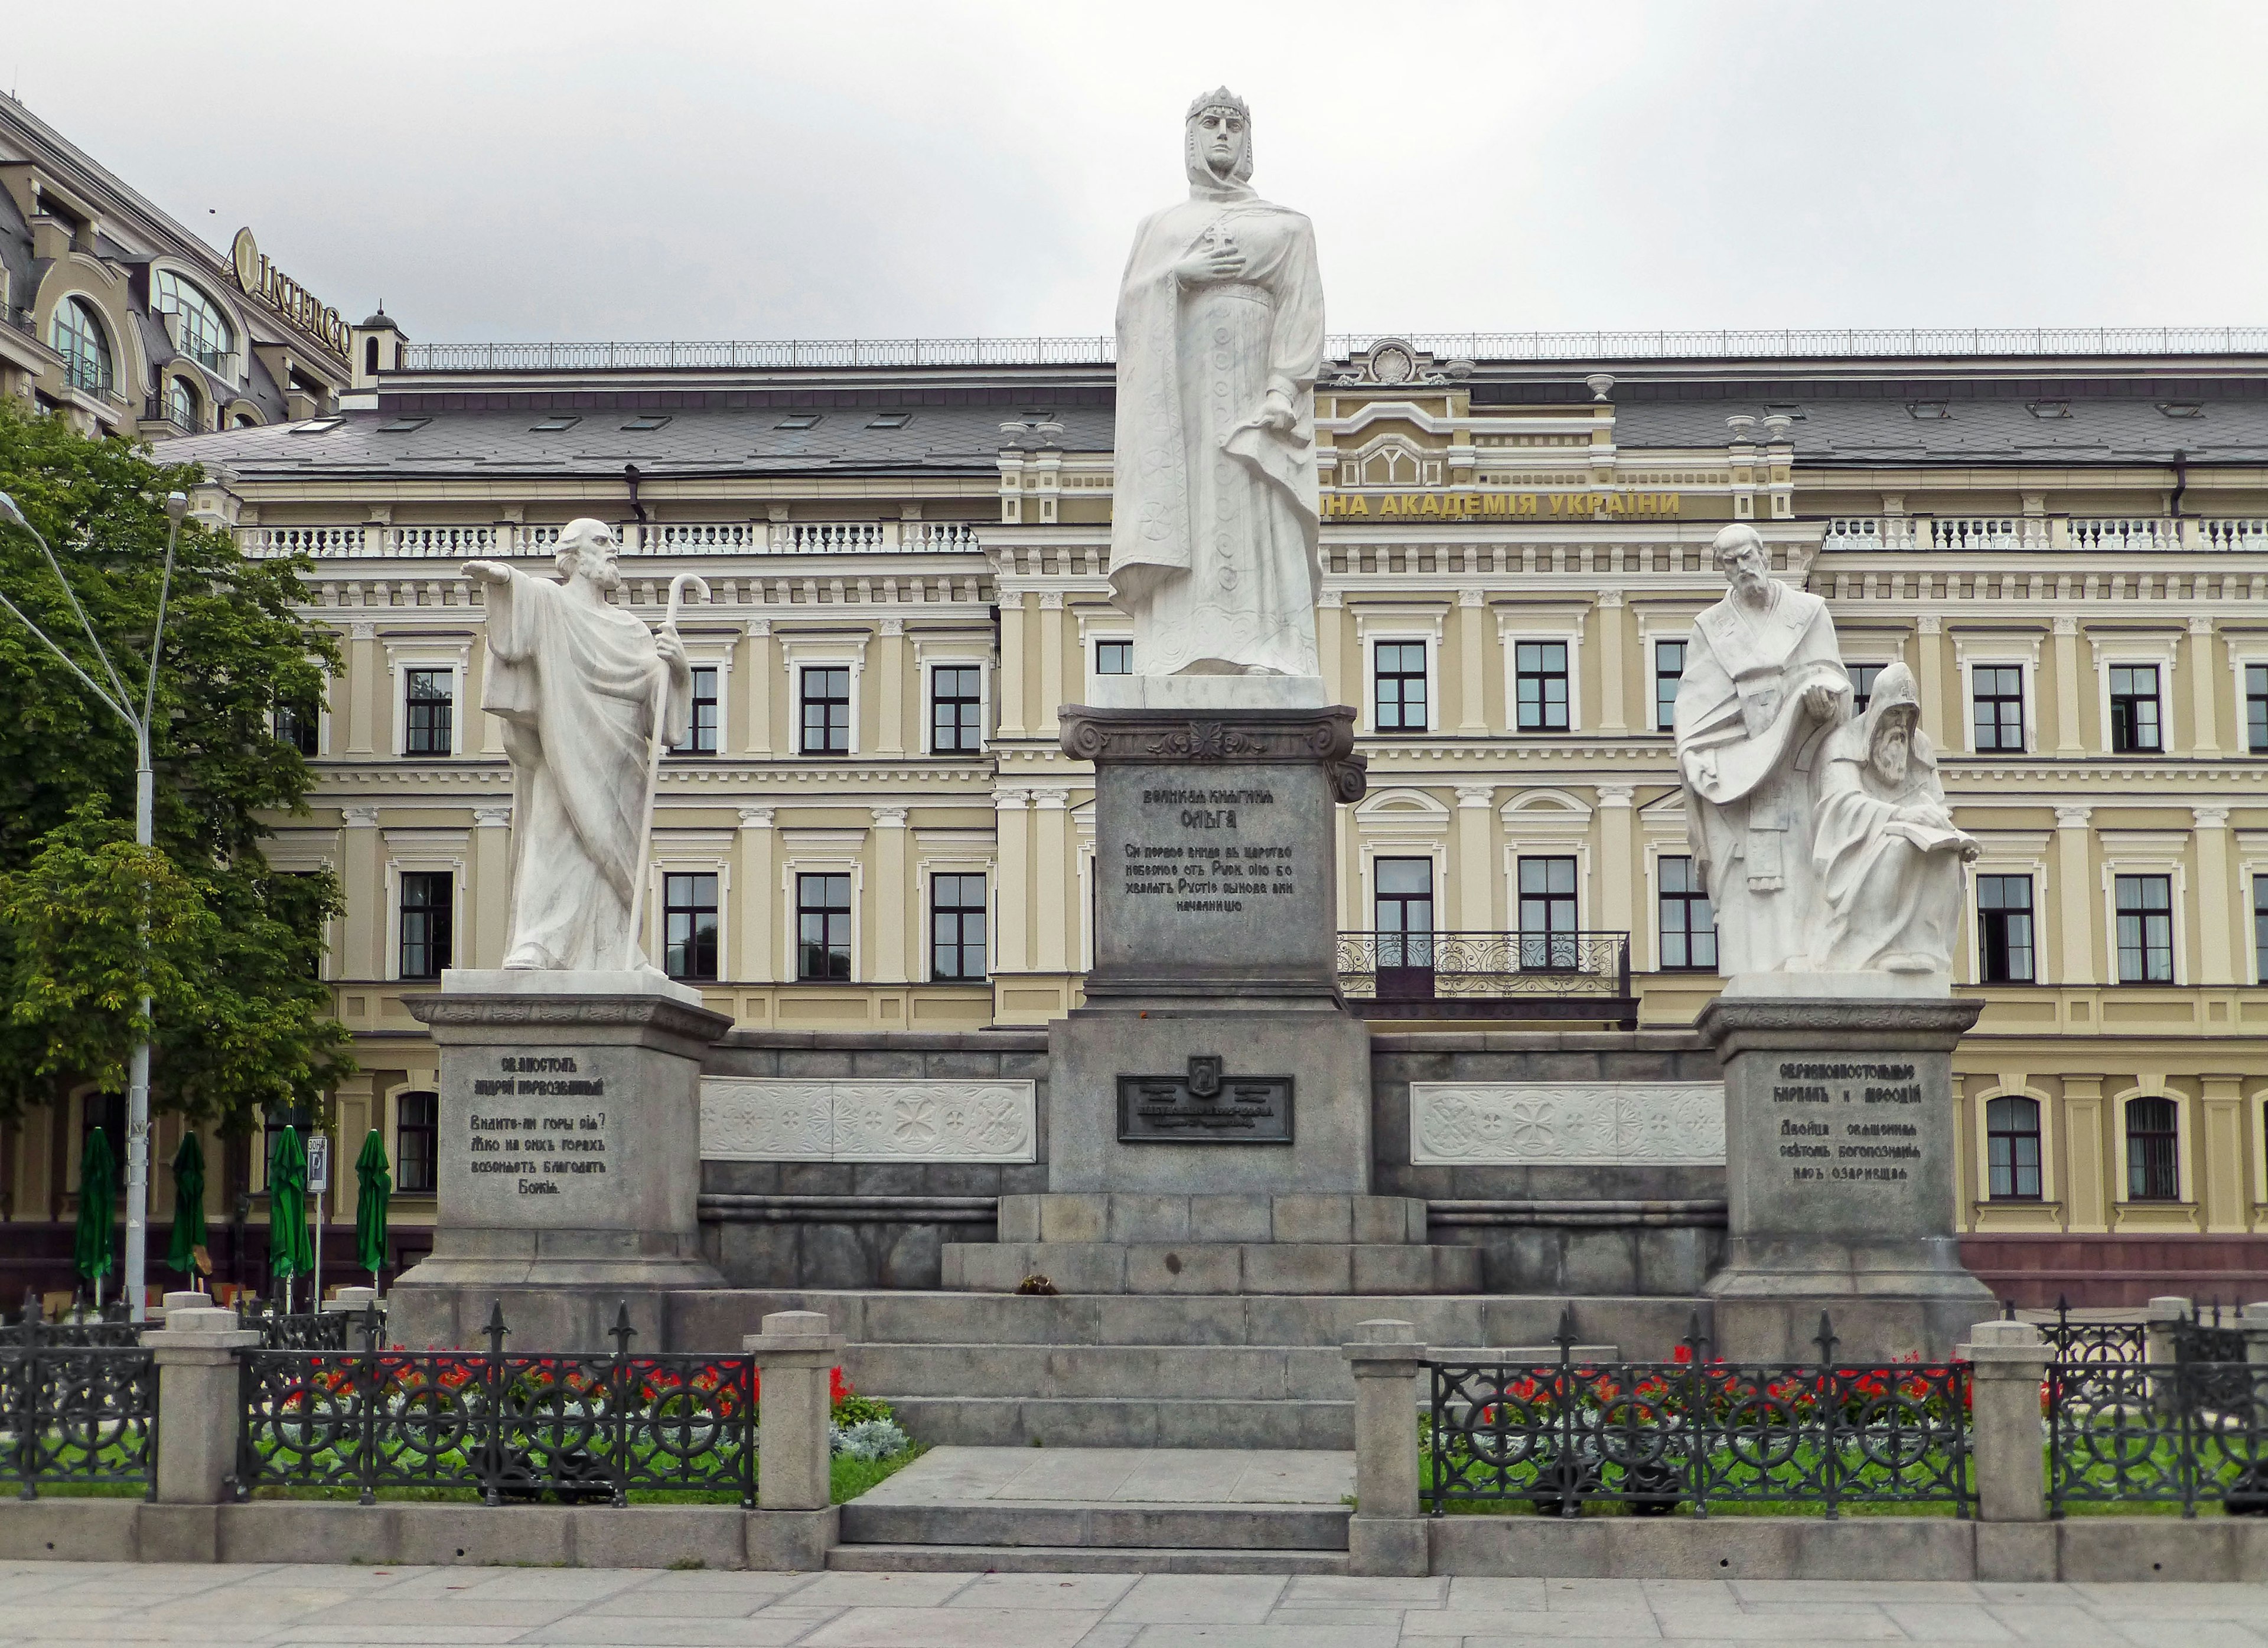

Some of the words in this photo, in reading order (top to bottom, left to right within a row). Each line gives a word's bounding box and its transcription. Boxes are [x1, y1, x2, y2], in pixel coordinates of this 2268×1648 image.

[1380, 494, 1537, 520] АКАДЕМІЯ
[1549, 488, 1680, 515] УКРАЇНИ
[312, 1153, 321, 1177] P
